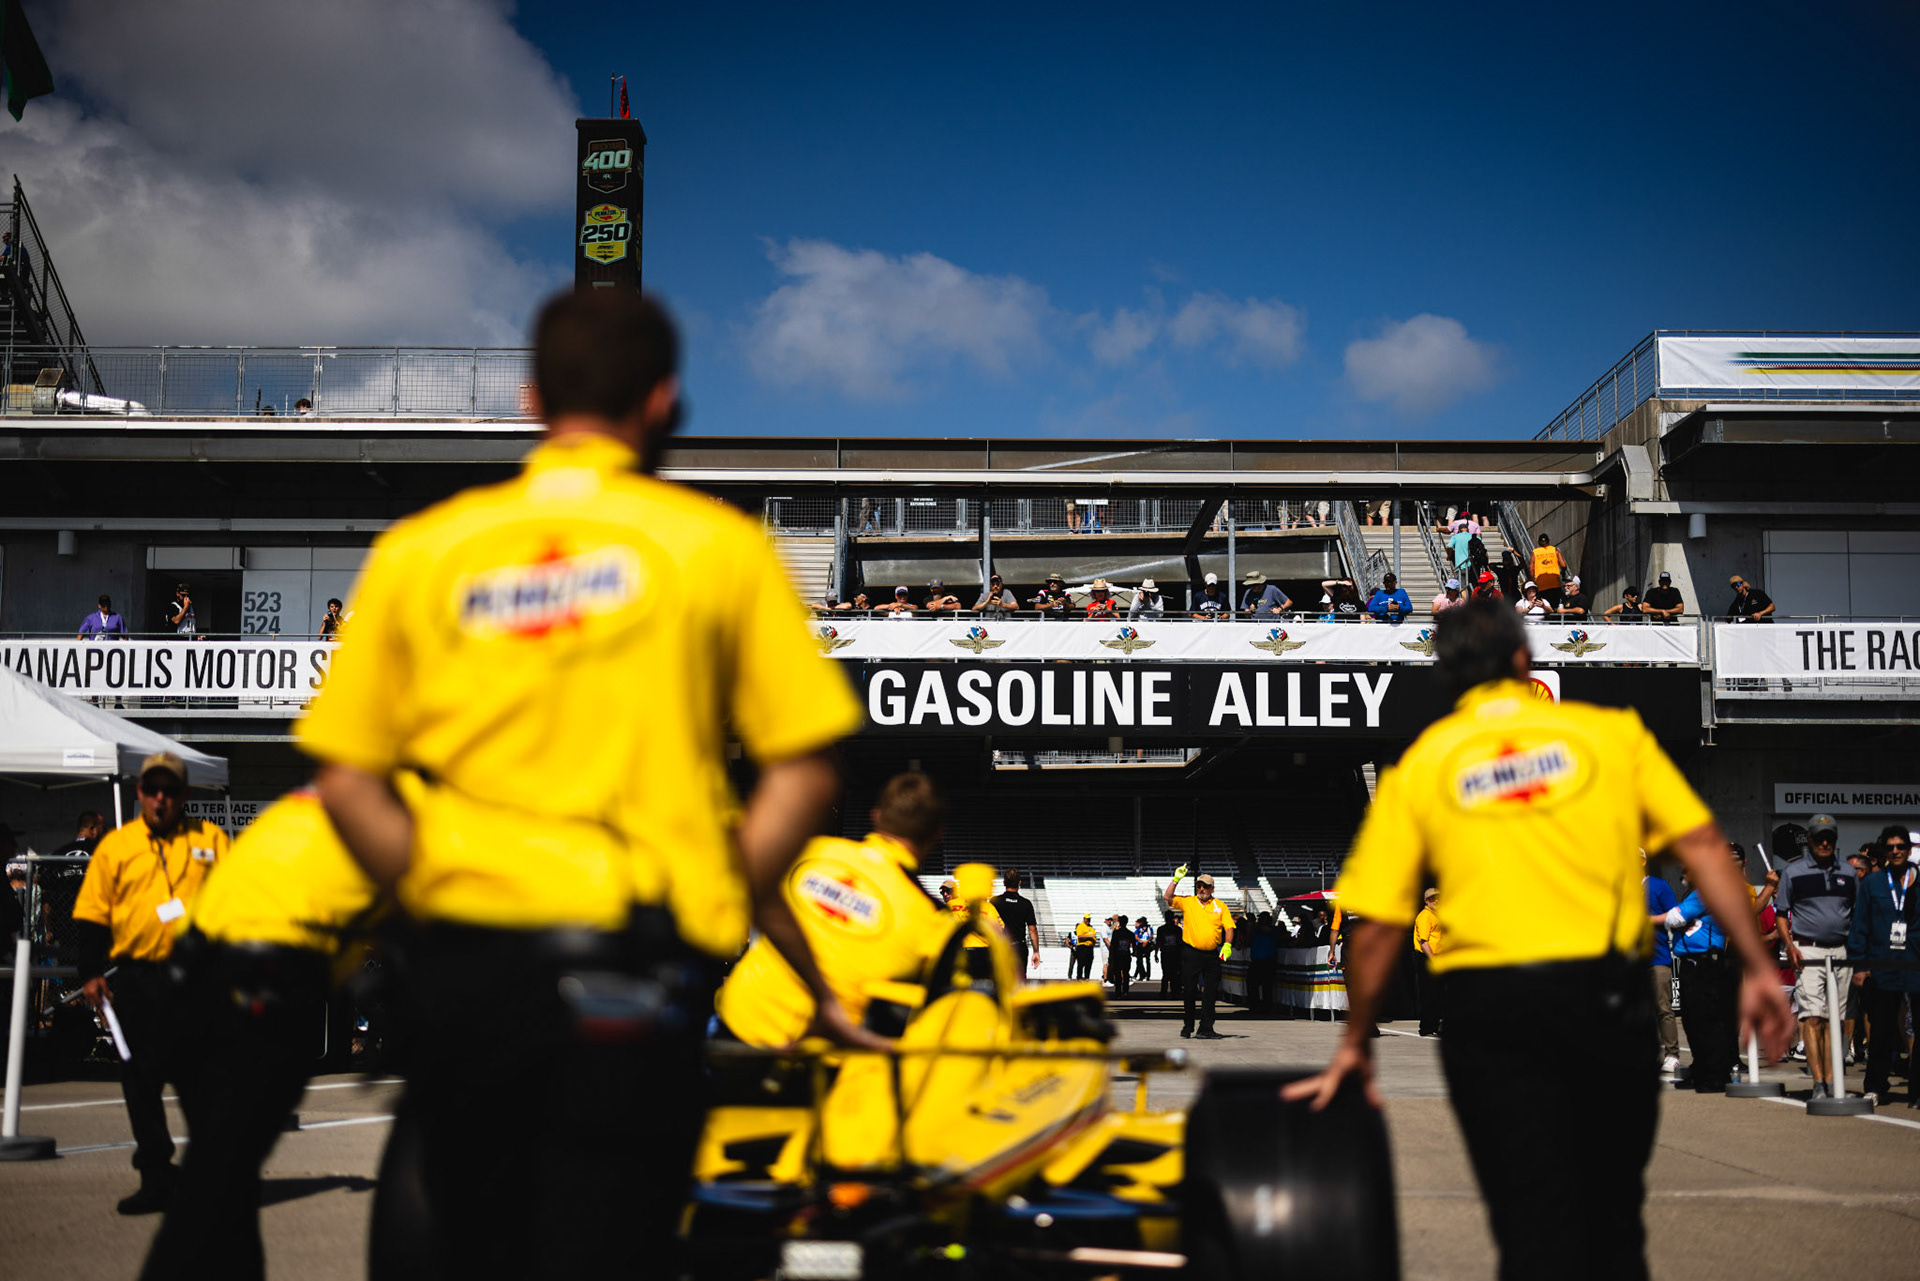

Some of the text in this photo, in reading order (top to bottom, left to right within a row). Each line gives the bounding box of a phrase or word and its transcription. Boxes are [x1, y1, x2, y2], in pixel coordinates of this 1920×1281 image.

[584, 150, 631, 171] 400
[582, 223, 630, 243] 250
[244, 591, 282, 613] 523
[243, 615, 281, 636] 524
[1795, 630, 1856, 671] THE
[0, 647, 172, 689] IANAPOLIS
[184, 648, 297, 690] MOTOR
[868, 669, 1394, 728] GASOLINE ALLEY
[202, 803, 257, 814] TERRACE
[1784, 792, 1849, 805] OFFICIAL
